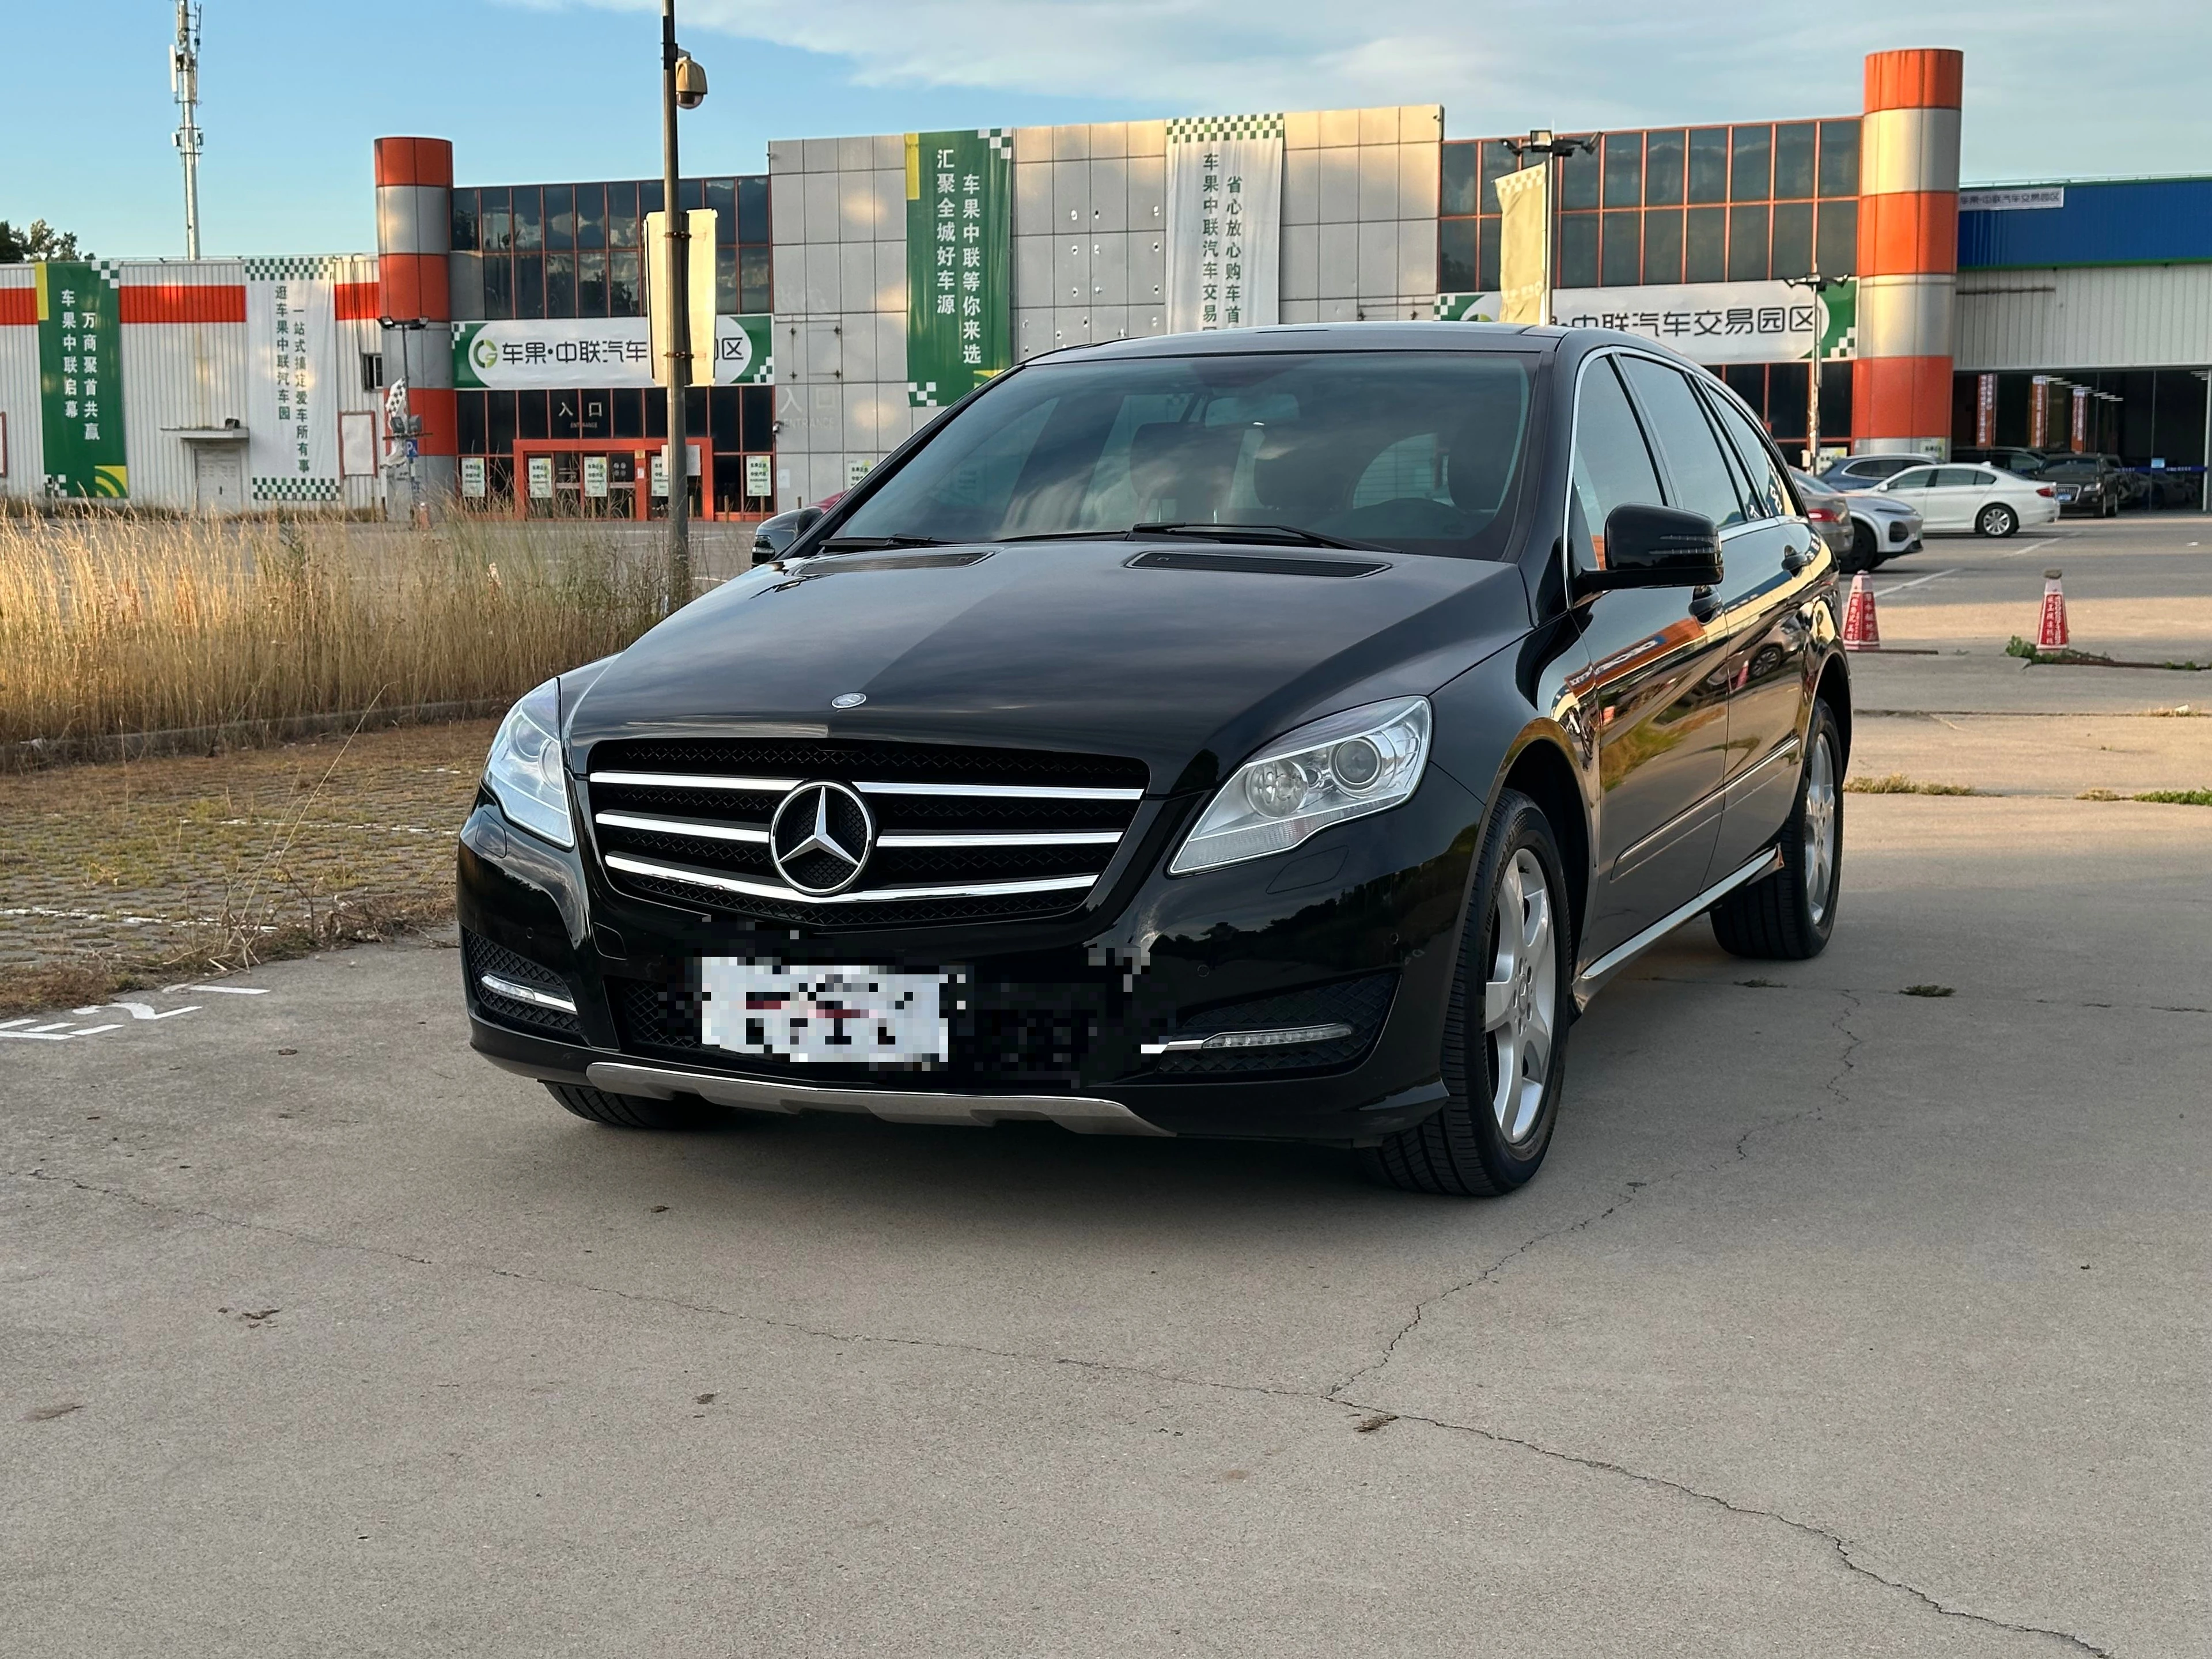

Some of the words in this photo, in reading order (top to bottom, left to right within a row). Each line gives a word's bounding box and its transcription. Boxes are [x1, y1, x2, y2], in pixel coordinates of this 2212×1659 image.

[937, 149, 956, 315] 汇聚全城好车源
[963, 174, 982, 365] 车果中联等你来选
[1203, 153, 1219, 330] 车果中联汽车交易
[61, 290, 78, 419] 车果中联启幕
[82, 312, 100, 441] 万商聚首共赢
[275, 286, 290, 421] 逛车果中联汽车园
[293, 309, 310, 474] 一站式搞定爱车所有事
[502, 336, 744, 364] 车果·中联汽车区
[558, 402, 603, 416] 入口
